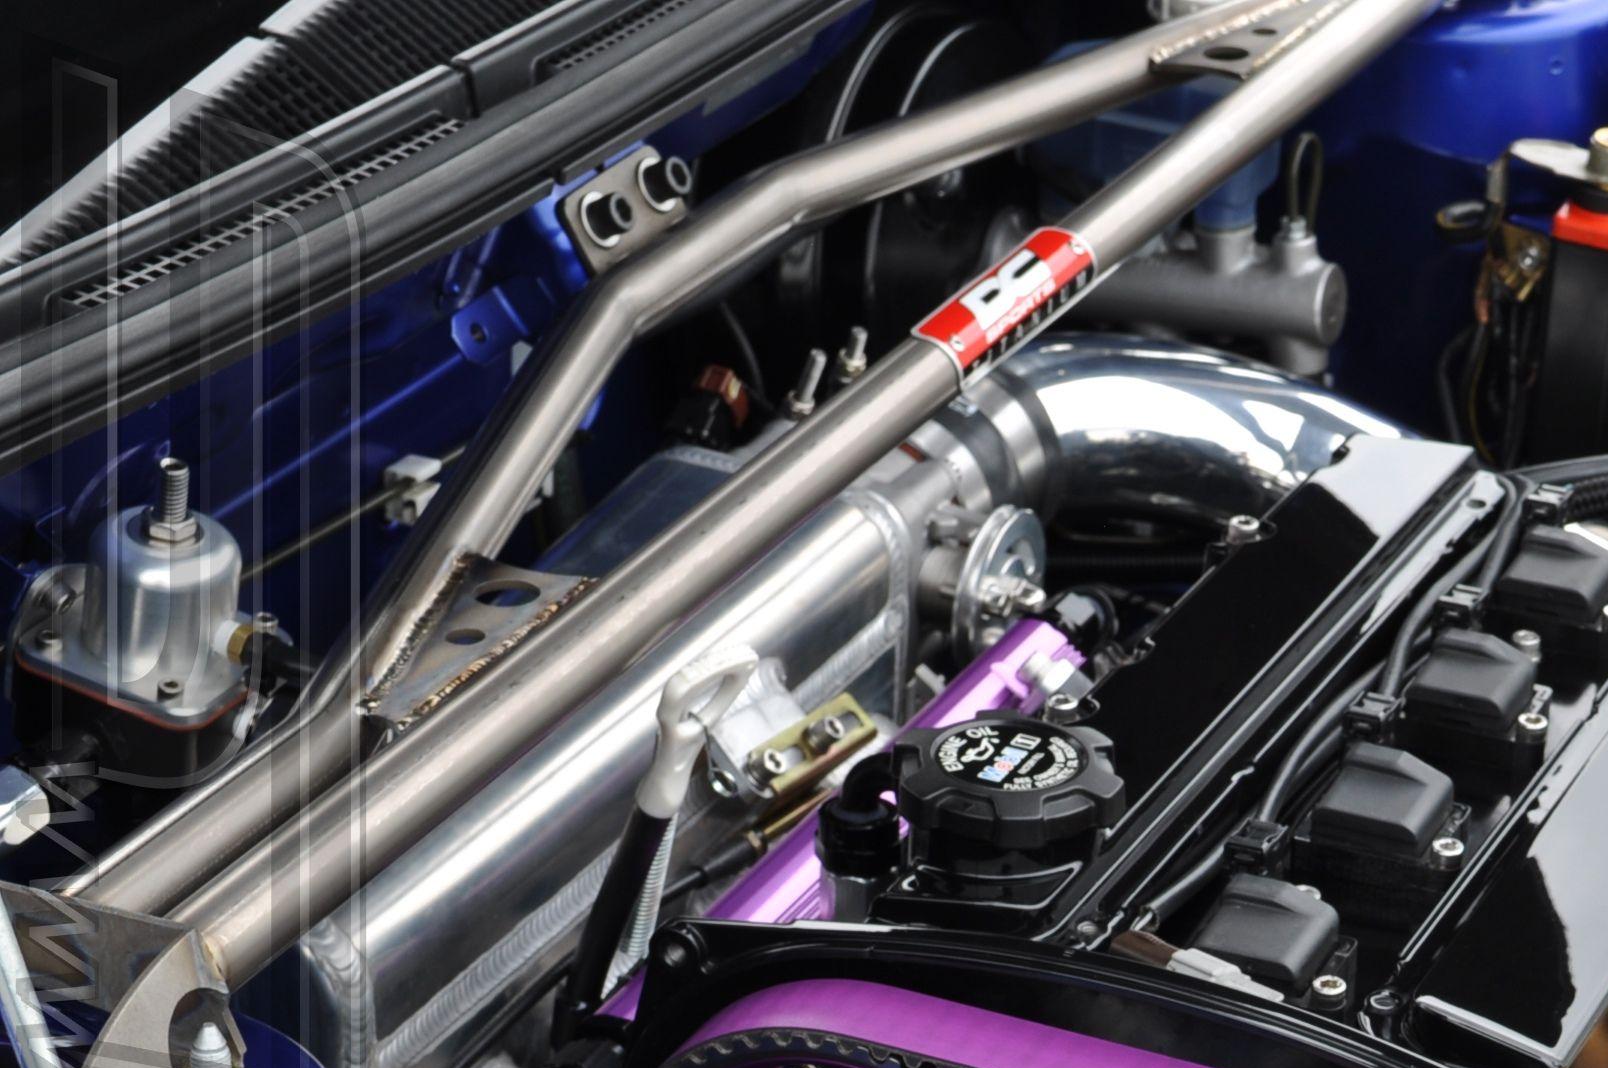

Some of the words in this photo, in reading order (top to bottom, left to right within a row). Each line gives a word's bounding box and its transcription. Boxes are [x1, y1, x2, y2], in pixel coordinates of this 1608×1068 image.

[959, 248, 1052, 331] DC
[938, 735, 968, 772] ENGINE
[965, 726, 1000, 739] OIL
